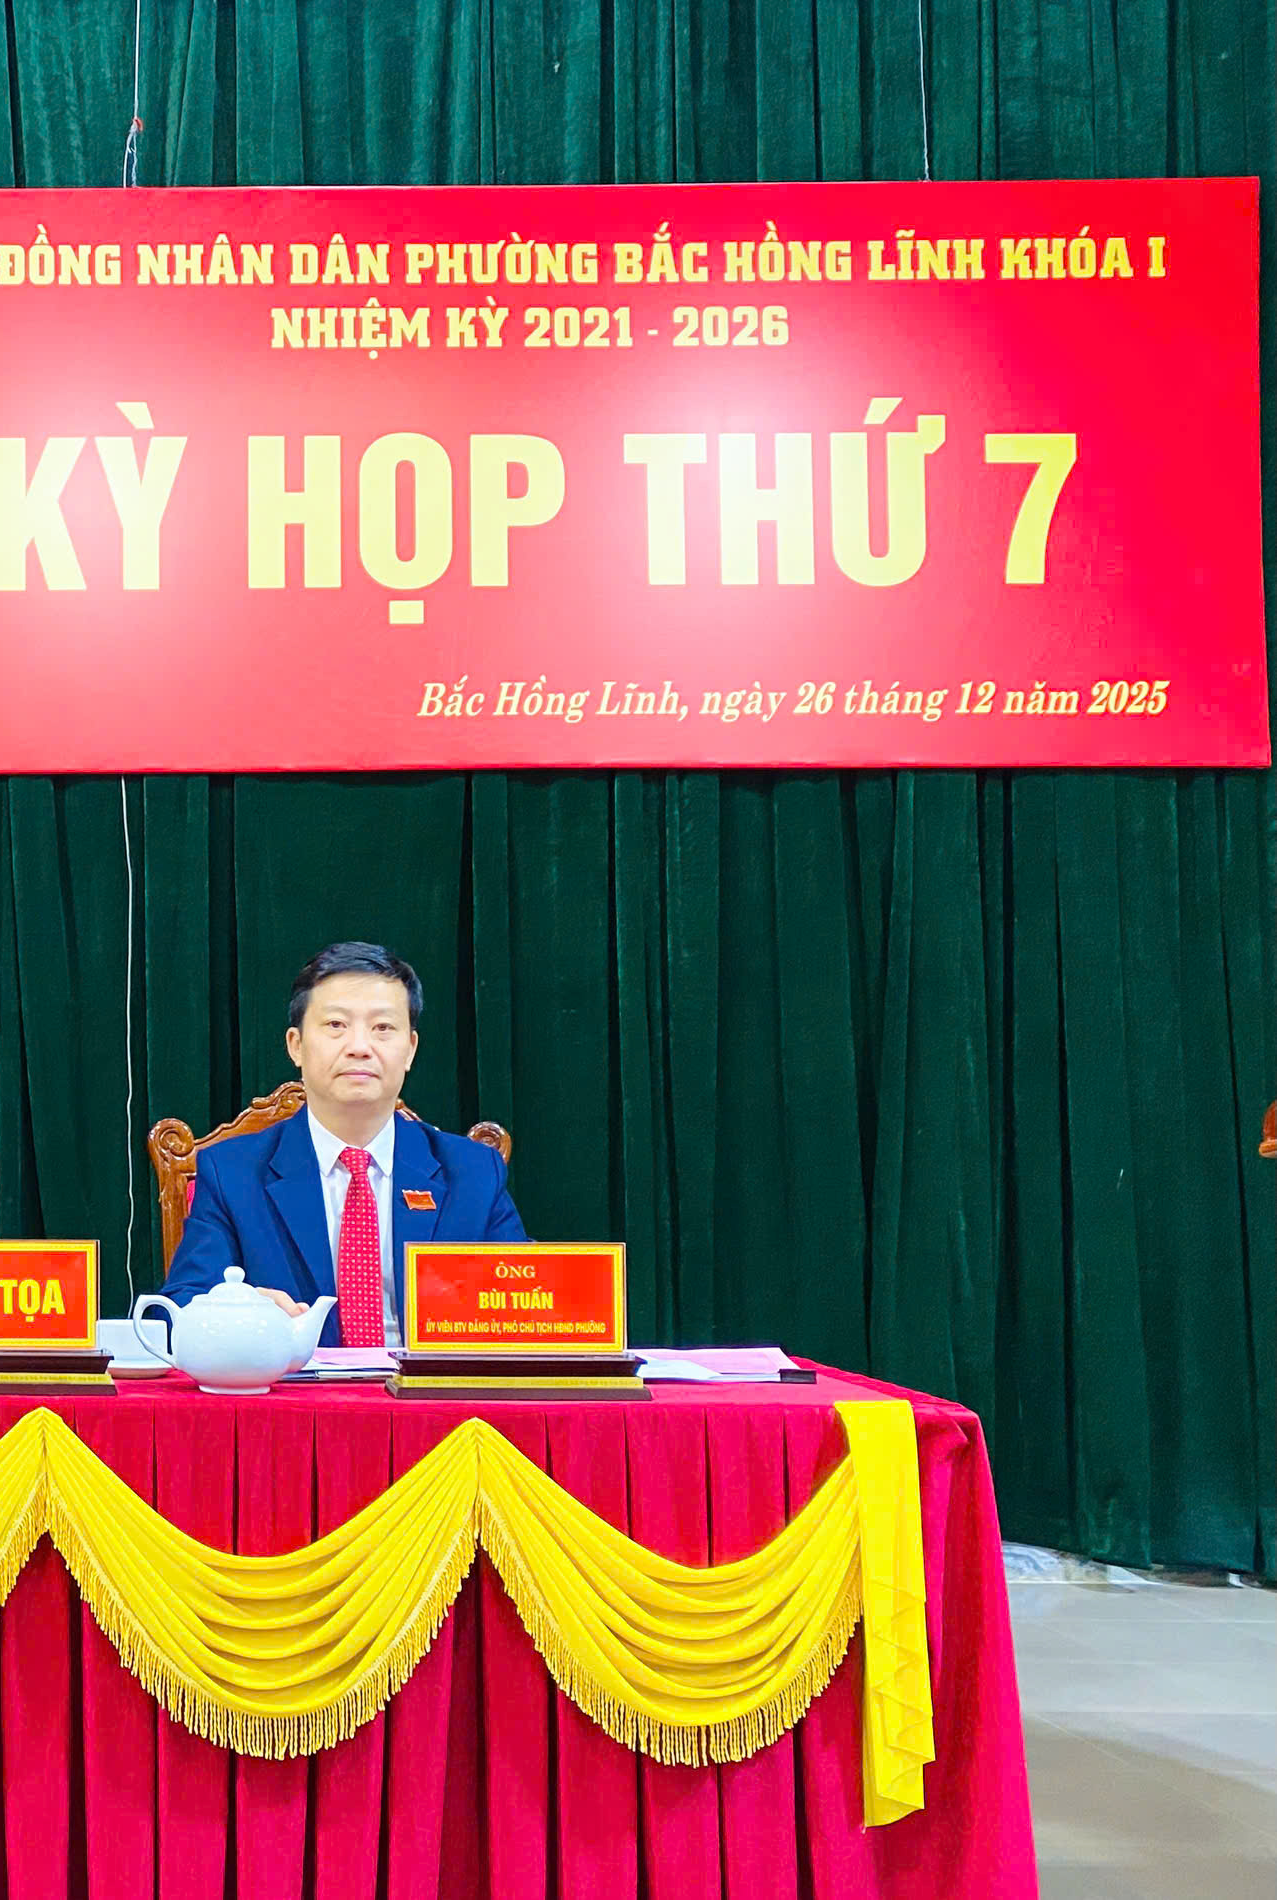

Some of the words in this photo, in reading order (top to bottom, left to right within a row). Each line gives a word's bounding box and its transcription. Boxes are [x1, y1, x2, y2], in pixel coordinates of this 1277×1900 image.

[137, 233, 274, 285] NHÂN
[289, 233, 390, 285] DÂN
[405, 231, 599, 284] PHƯỜNG
[613, 221, 709, 283] BẮC
[724, 220, 852, 282] HỒNG
[867, 229, 985, 281] LĨNH
[1000, 225, 1134, 279] KHÓA
[1147, 236, 1167, 278] I
[271, 296, 431, 360] NHIỆM
[446, 296, 509, 348] KỲ
[524, 306, 633, 348] 2021
[672, 306, 790, 347] 2026
[247, 431, 566, 625] HỌP
[623, 397, 946, 587] THỨ
[984, 432, 1078, 585] 7
[417, 675, 485, 718] Bắc
[492, 674, 590, 723] Hồng
[595, 680, 689, 722] Lĩnh,
[698, 681, 787, 722] ngày
[793, 680, 837, 714] 26
[844, 680, 949, 722] tháng
[954, 680, 997, 714] 12
[1002, 681, 1079, 714] năm
[1086, 680, 1171, 715] 2025
[495, 1261, 536, 1279] ÔNG
[478, 1288, 506, 1309] BÙI
[510, 1286, 554, 1310] TUẤN
[454, 1321, 467, 1333] BTV
